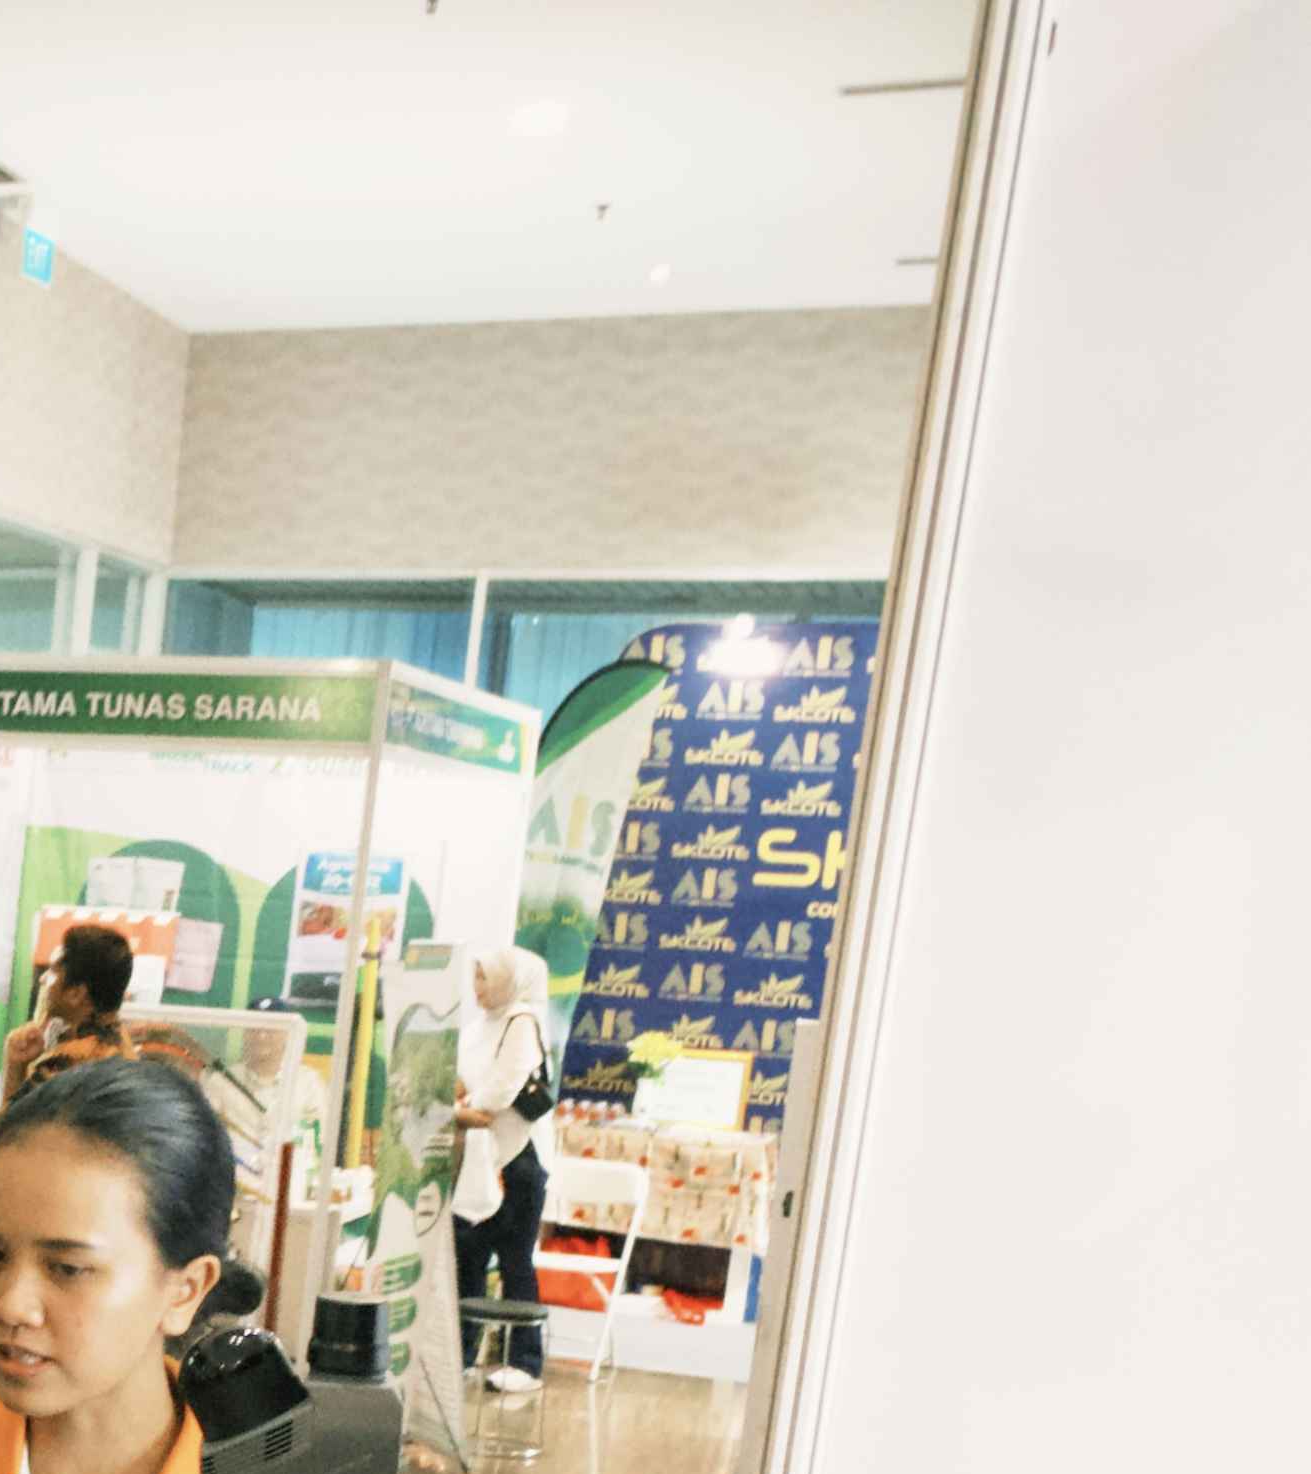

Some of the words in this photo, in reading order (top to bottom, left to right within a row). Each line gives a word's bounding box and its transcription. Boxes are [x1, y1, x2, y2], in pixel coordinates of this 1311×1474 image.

[85, 690, 187, 720] TUNAS
[193, 693, 322, 722] SARANA
[697, 680, 765, 713] AIS
[771, 730, 841, 765] AIS
[683, 773, 751, 806] AIS
[671, 867, 738, 900] AIS
[745, 920, 812, 953] AIS
[659, 962, 725, 997] AIS
